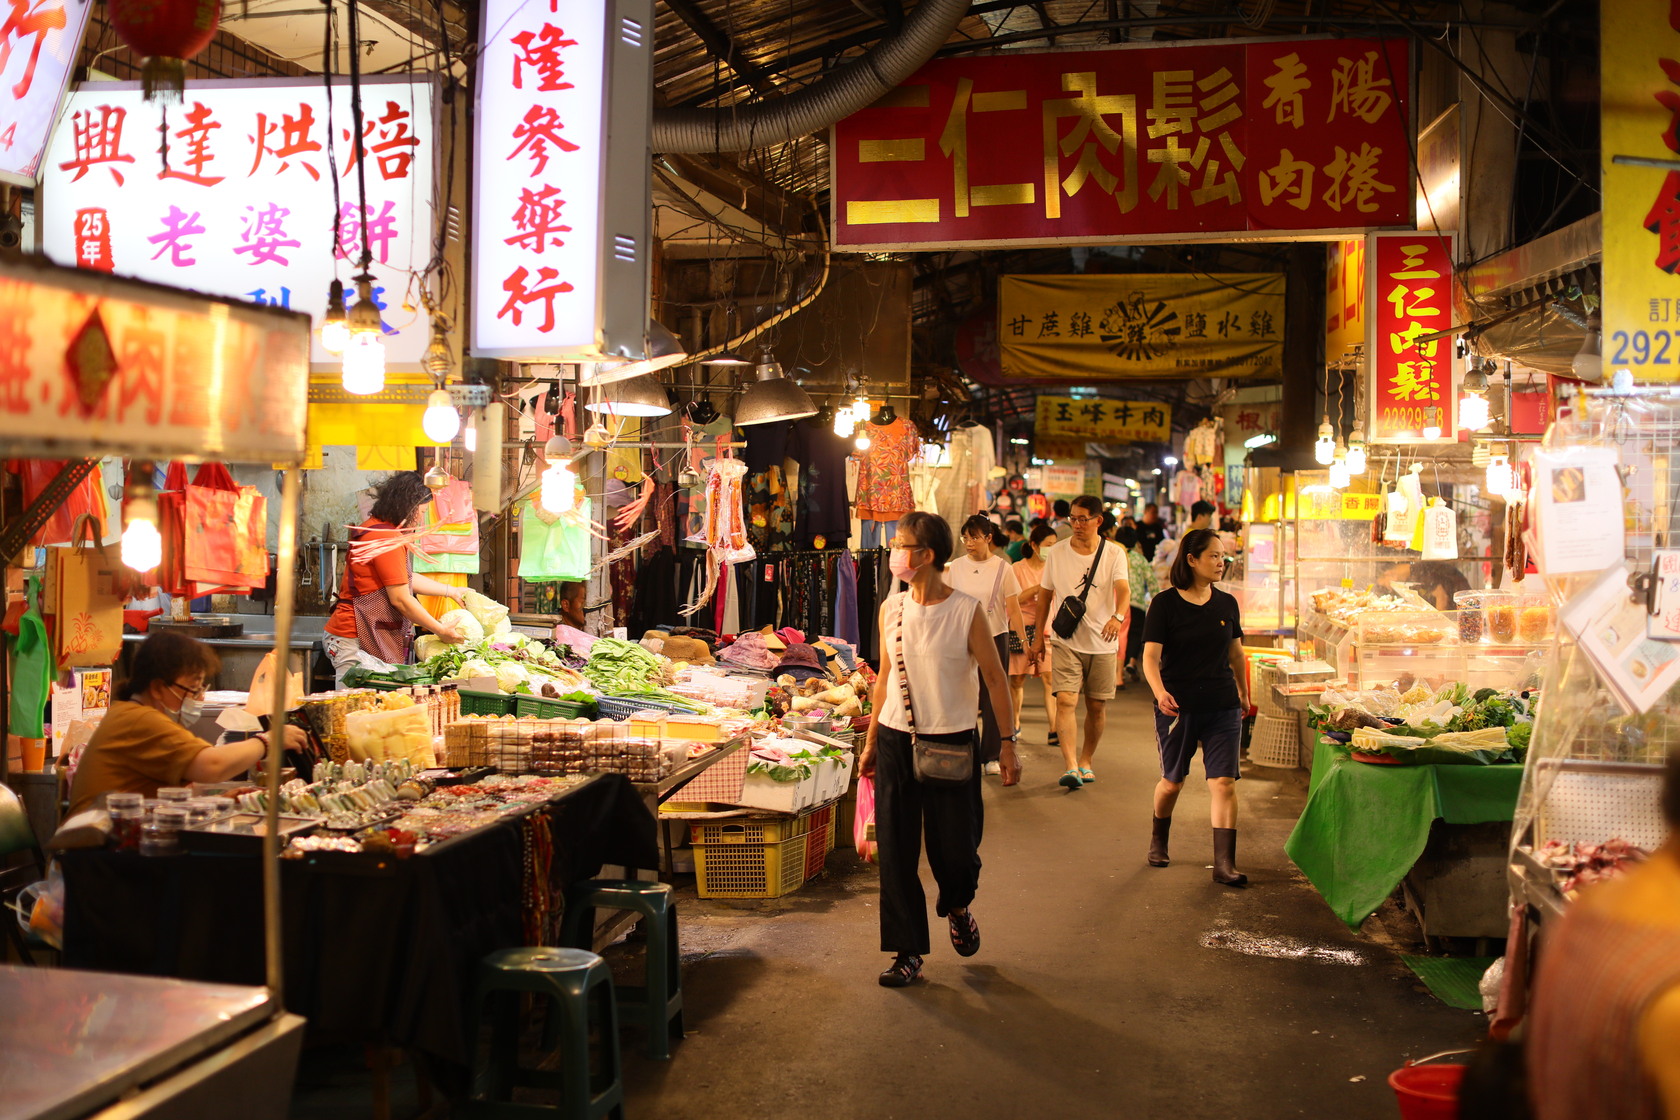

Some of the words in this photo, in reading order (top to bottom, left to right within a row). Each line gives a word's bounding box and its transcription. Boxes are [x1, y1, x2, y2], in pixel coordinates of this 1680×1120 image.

[1262, 51, 1392, 129] 香腸
[58, 100, 421, 188] 興達烘焙
[497, 0, 580, 333] 隆參藥行
[847, 67, 1246, 224] 三仁肉鬆
[1258, 142, 1397, 214] 肉捲
[81, 213, 102, 234] 25
[81, 240, 102, 265] 年
[146, 200, 399, 268] 老婆餅
[1007, 310, 1095, 340] 甘蔗雞
[1184, 309, 1276, 340] 鹽水雞
[1387, 244, 1441, 402] 三仁肉鬆
[1648, 297, 1680, 322] 訂
[1344, 496, 1380, 511] 香腸
